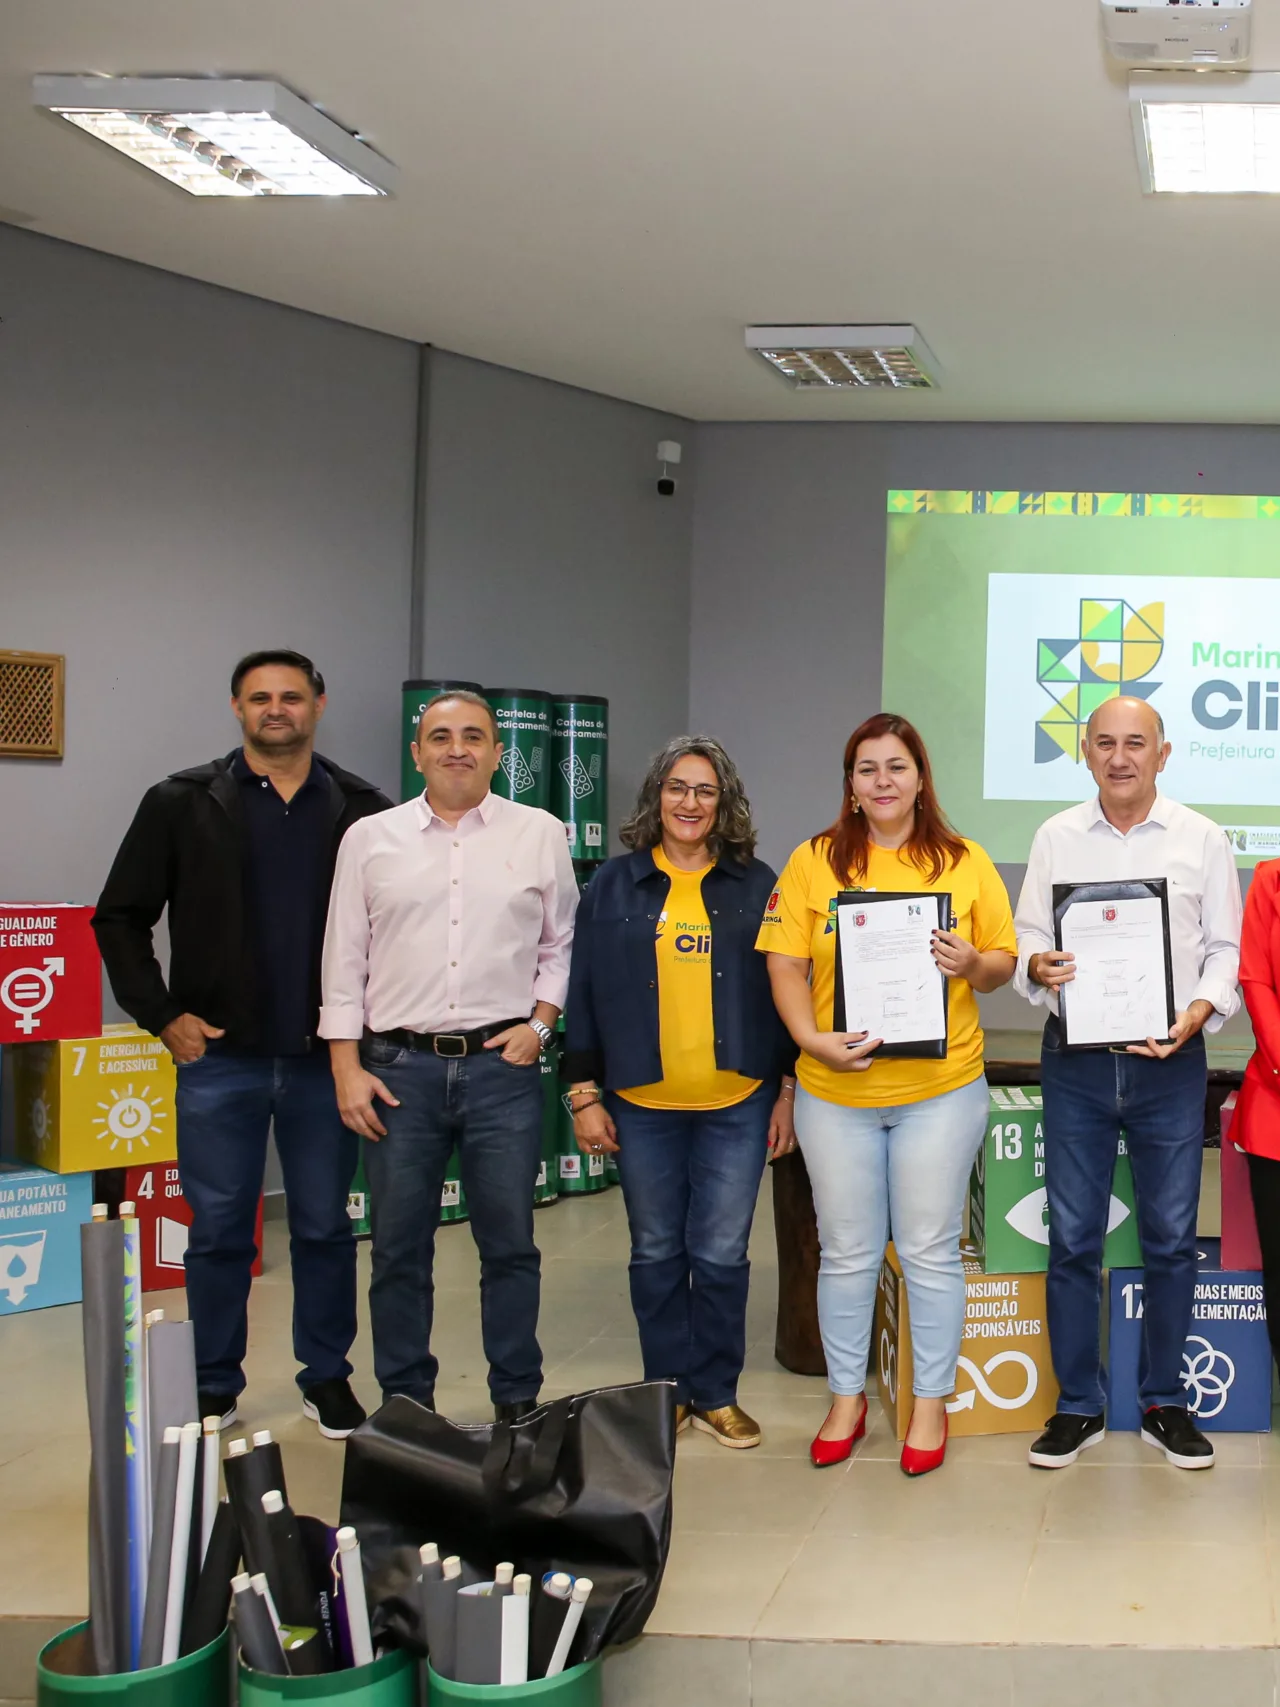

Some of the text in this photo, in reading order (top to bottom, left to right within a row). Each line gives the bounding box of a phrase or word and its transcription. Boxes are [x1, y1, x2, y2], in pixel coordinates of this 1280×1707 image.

[496, 708, 537, 719] Cartelas
[556, 718, 595, 728] Cartelas
[1190, 741, 1275, 761] Prefeitura
[9, 932, 54, 947] GÊNERO
[100, 1043, 141, 1058] ENERGIA
[72, 1047, 87, 1076] 7
[99, 1057, 158, 1074] E ACESSÍVEL
[991, 1123, 1023, 1160] 13
[17, 1183, 67, 1201] POTÁVEL
[137, 1171, 154, 1199] 4
[1012, 1281, 1019, 1296] E
[1221, 1285, 1227, 1300] E
[1229, 1285, 1263, 1301] MEIOS
